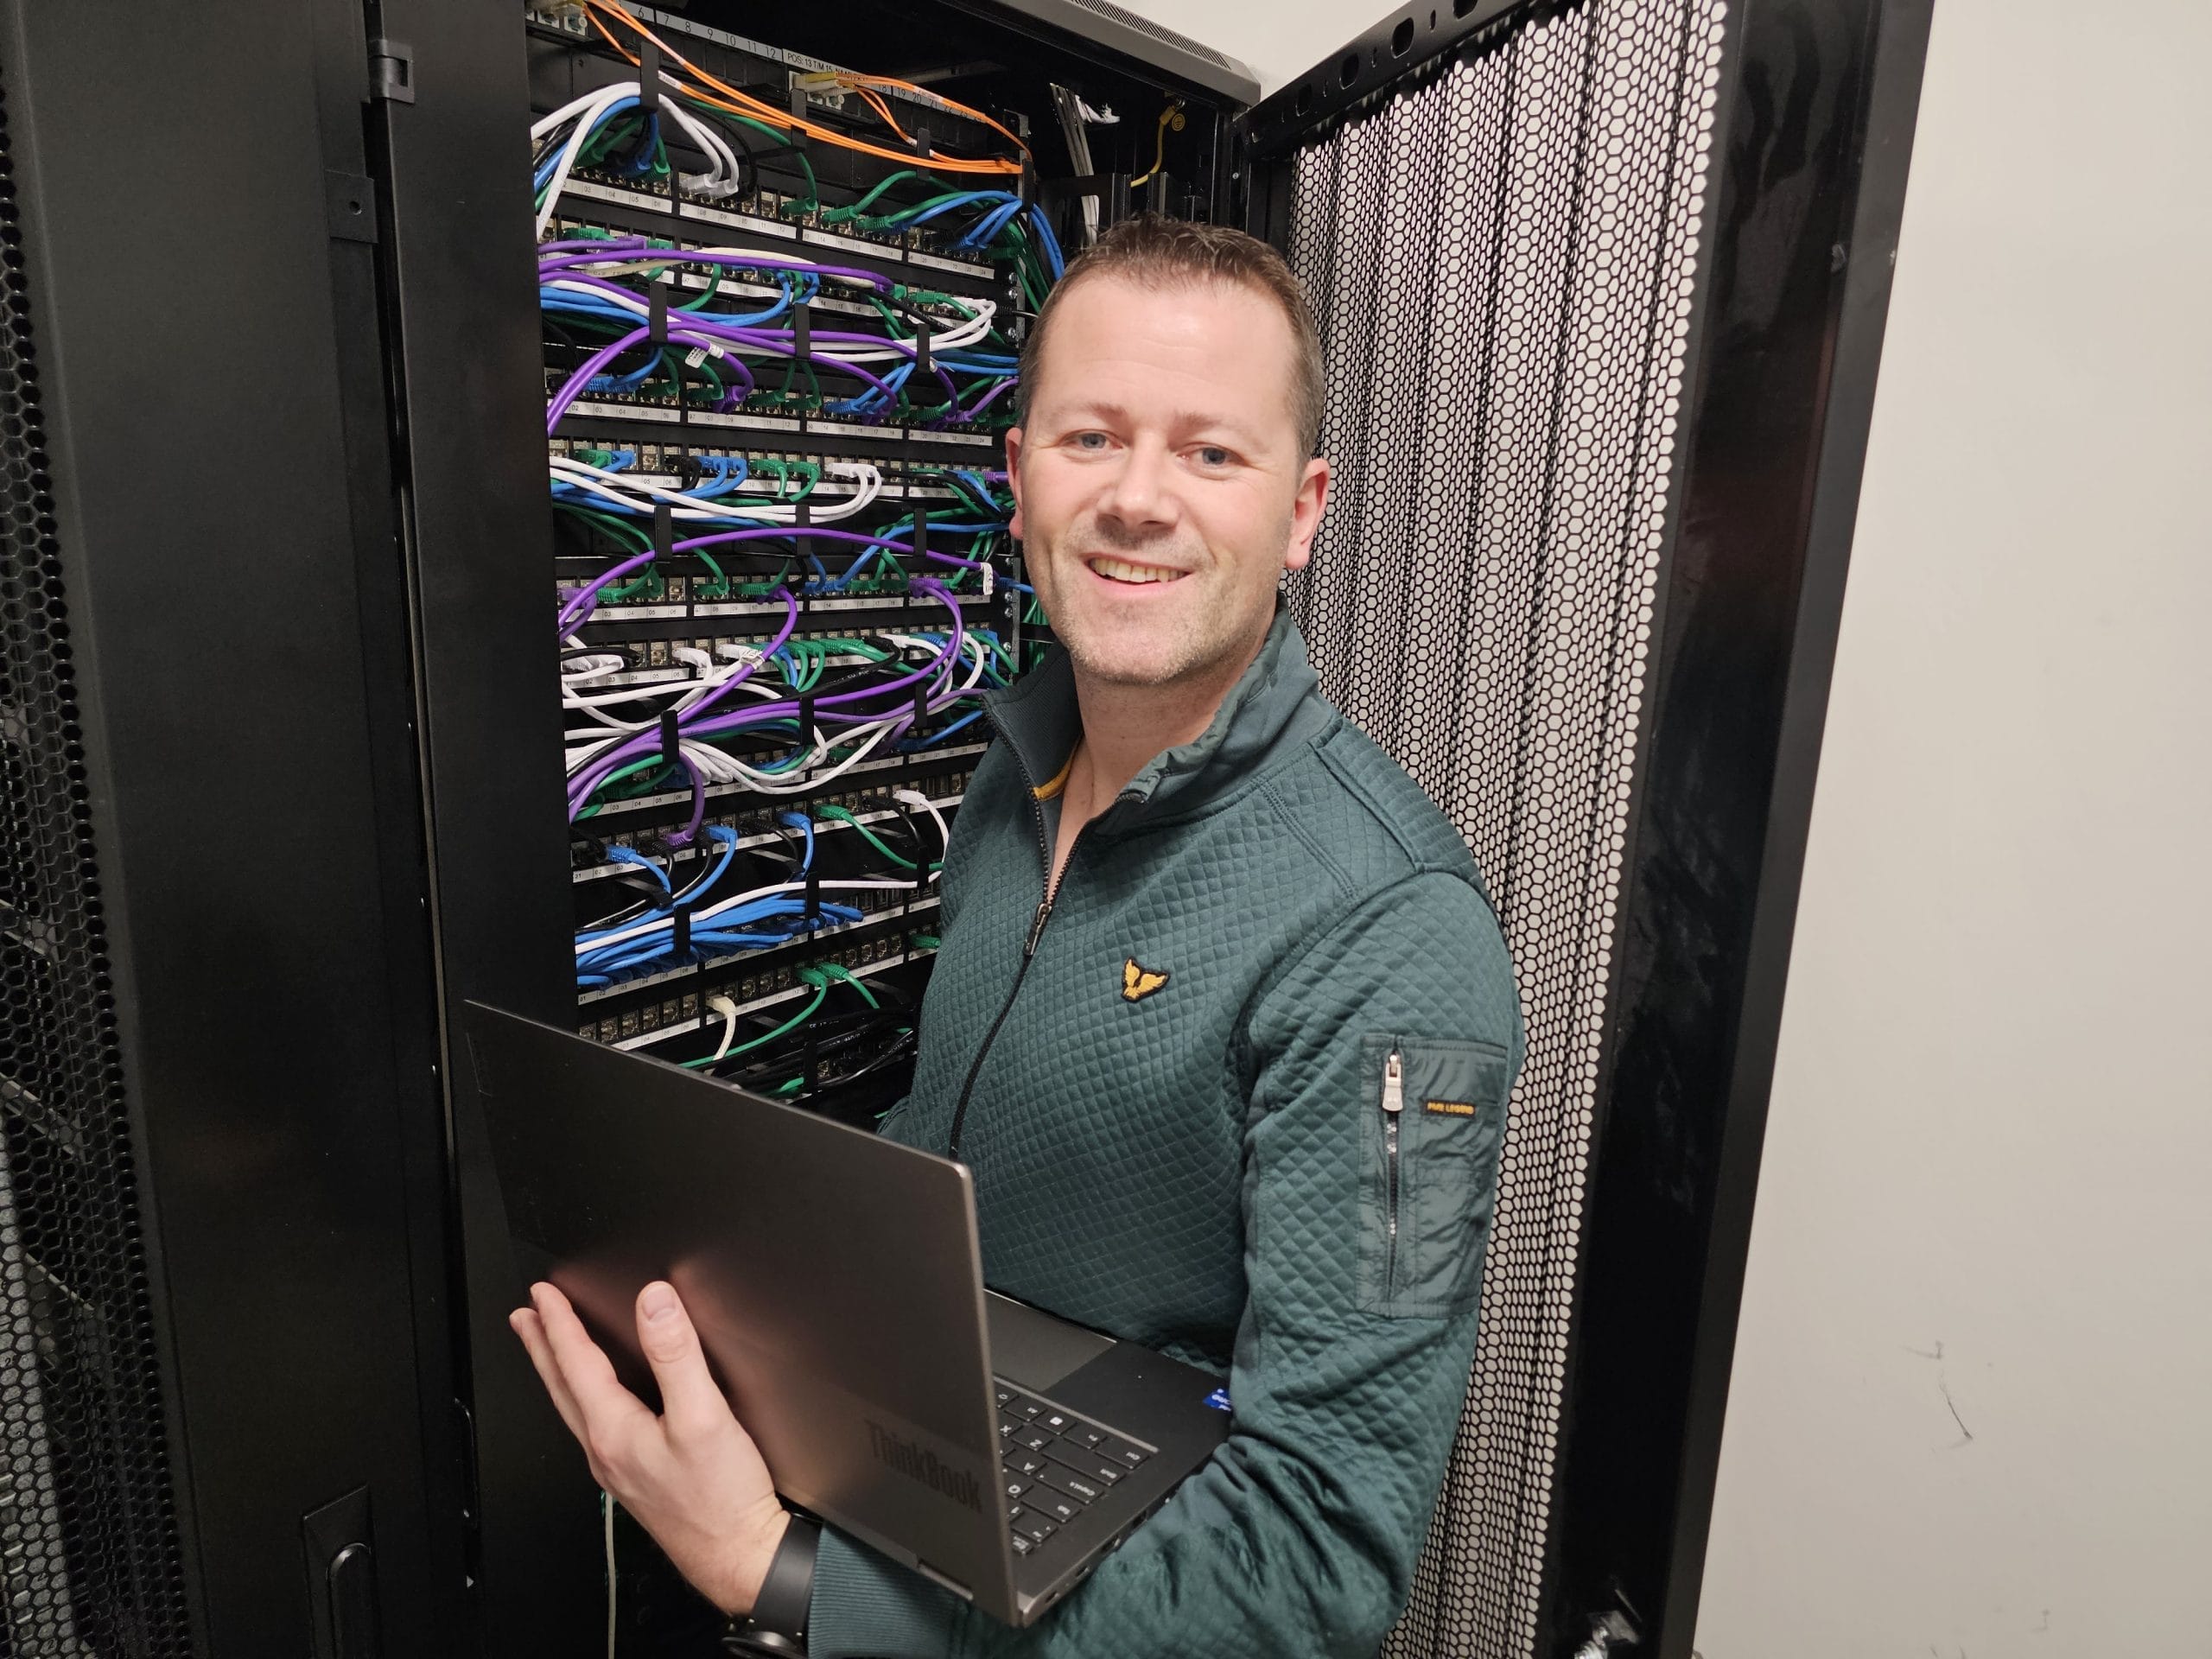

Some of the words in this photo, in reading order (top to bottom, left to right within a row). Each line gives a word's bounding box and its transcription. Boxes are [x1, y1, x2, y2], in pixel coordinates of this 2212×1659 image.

[639, 7, 645, 19] 6
[664, 14, 669, 25] 7
[685, 21, 691, 33] 8
[708, 29, 714, 40] 9
[726, 34, 736, 47] 10
[747, 41, 757, 53] 11
[766, 46, 776, 59] 12
[897, 87, 906, 99] 19
[912, 92, 922, 105] 20
[864, 1419, 982, 1515] ThinkBook
[1024, 1462, 1035, 1471] A
